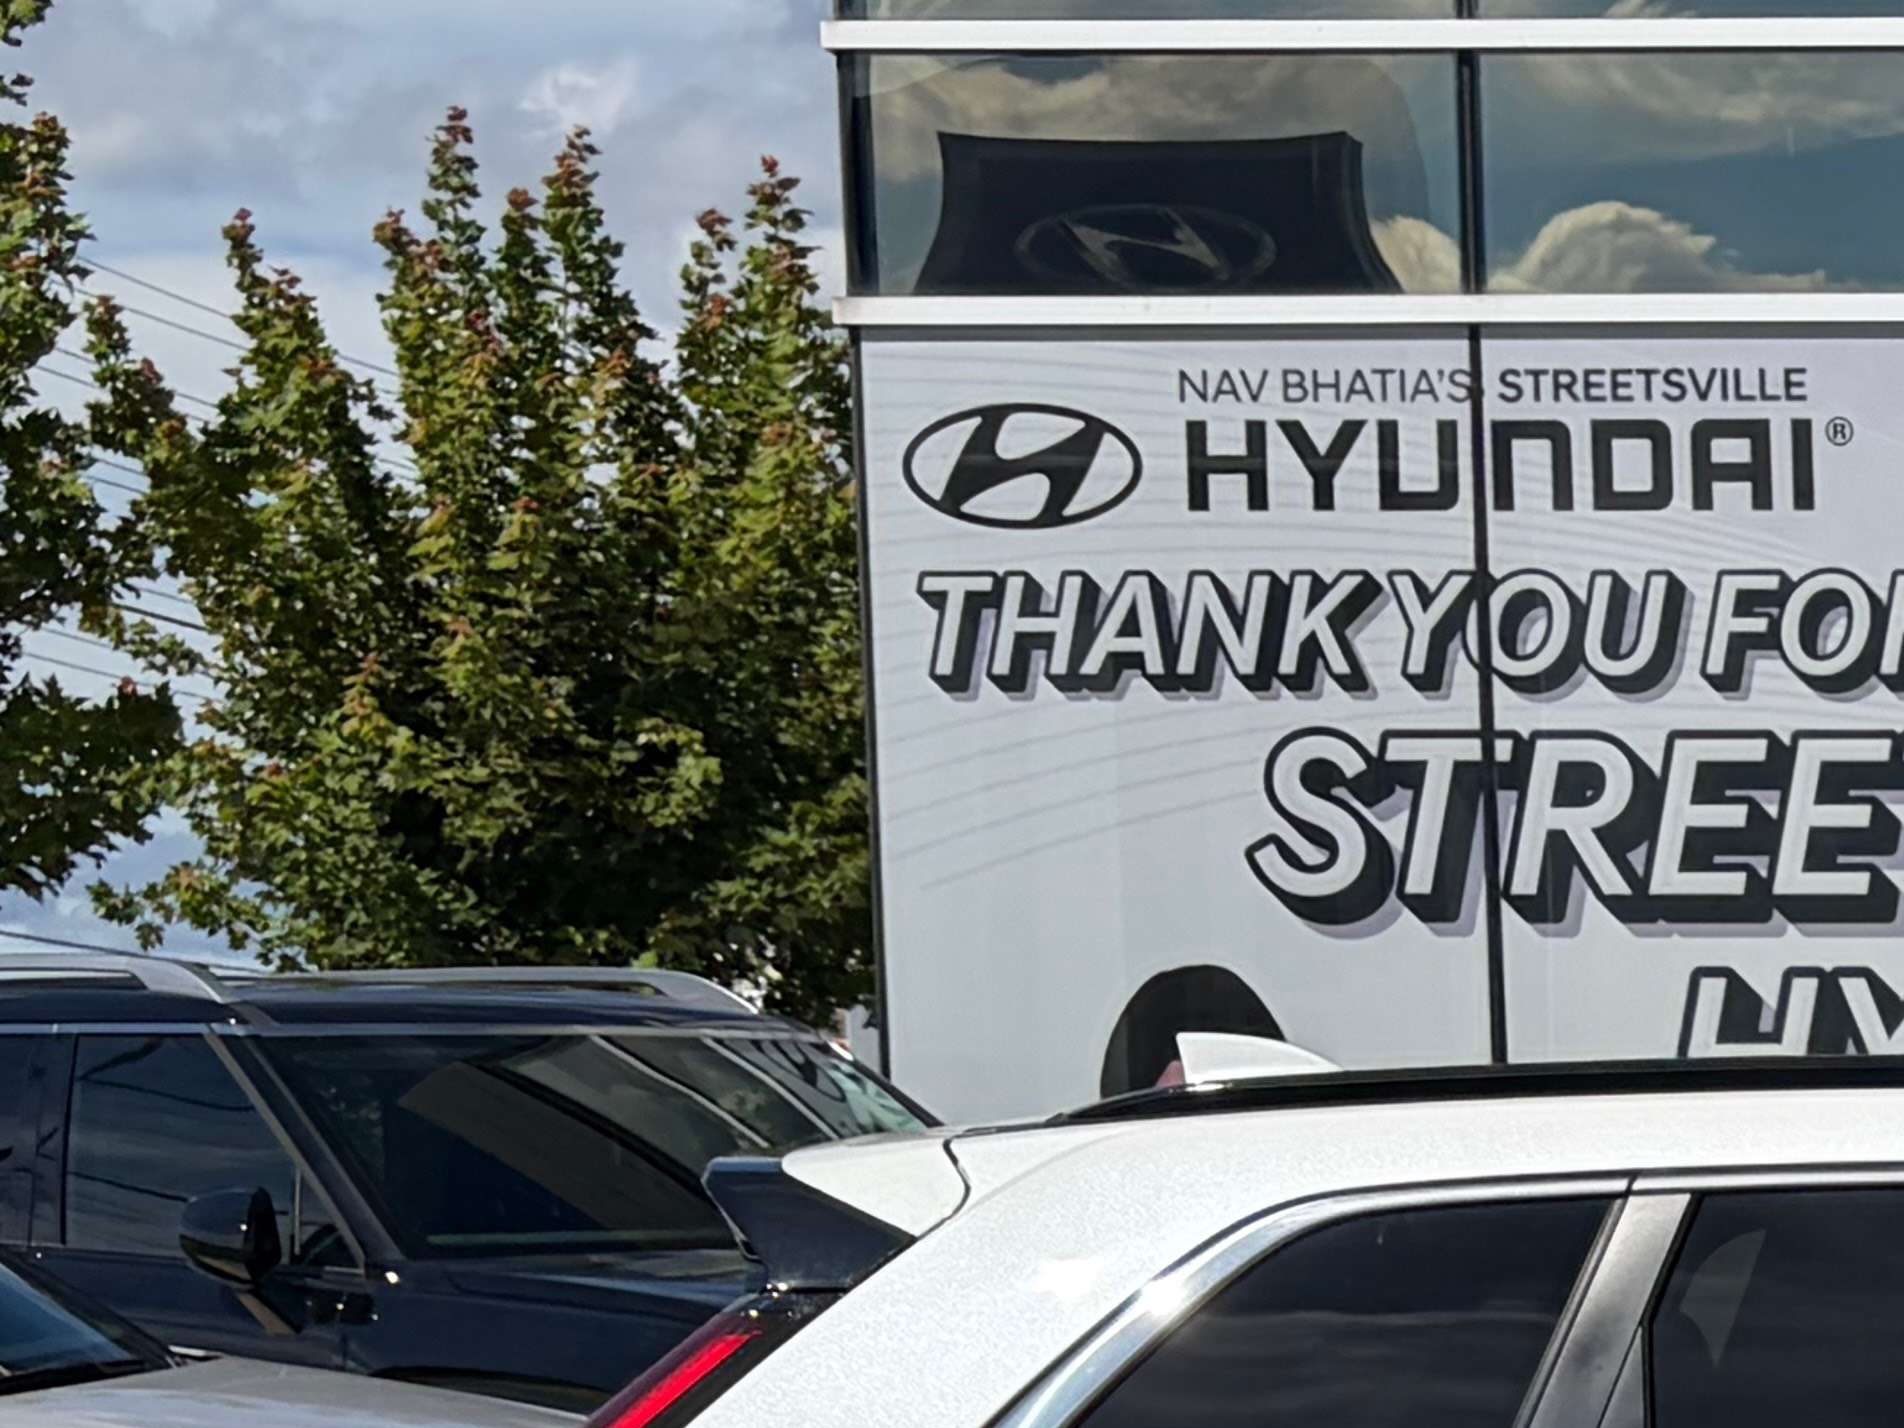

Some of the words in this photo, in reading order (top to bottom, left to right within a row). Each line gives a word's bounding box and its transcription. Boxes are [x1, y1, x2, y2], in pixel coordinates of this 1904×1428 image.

[1178, 368, 1270, 403] NAV
[1281, 368, 1485, 403] BHATIA'S
[1497, 368, 1808, 402] STREETSVILLE
[918, 570, 1385, 694] THANK
[1391, 568, 1692, 695] YOU
